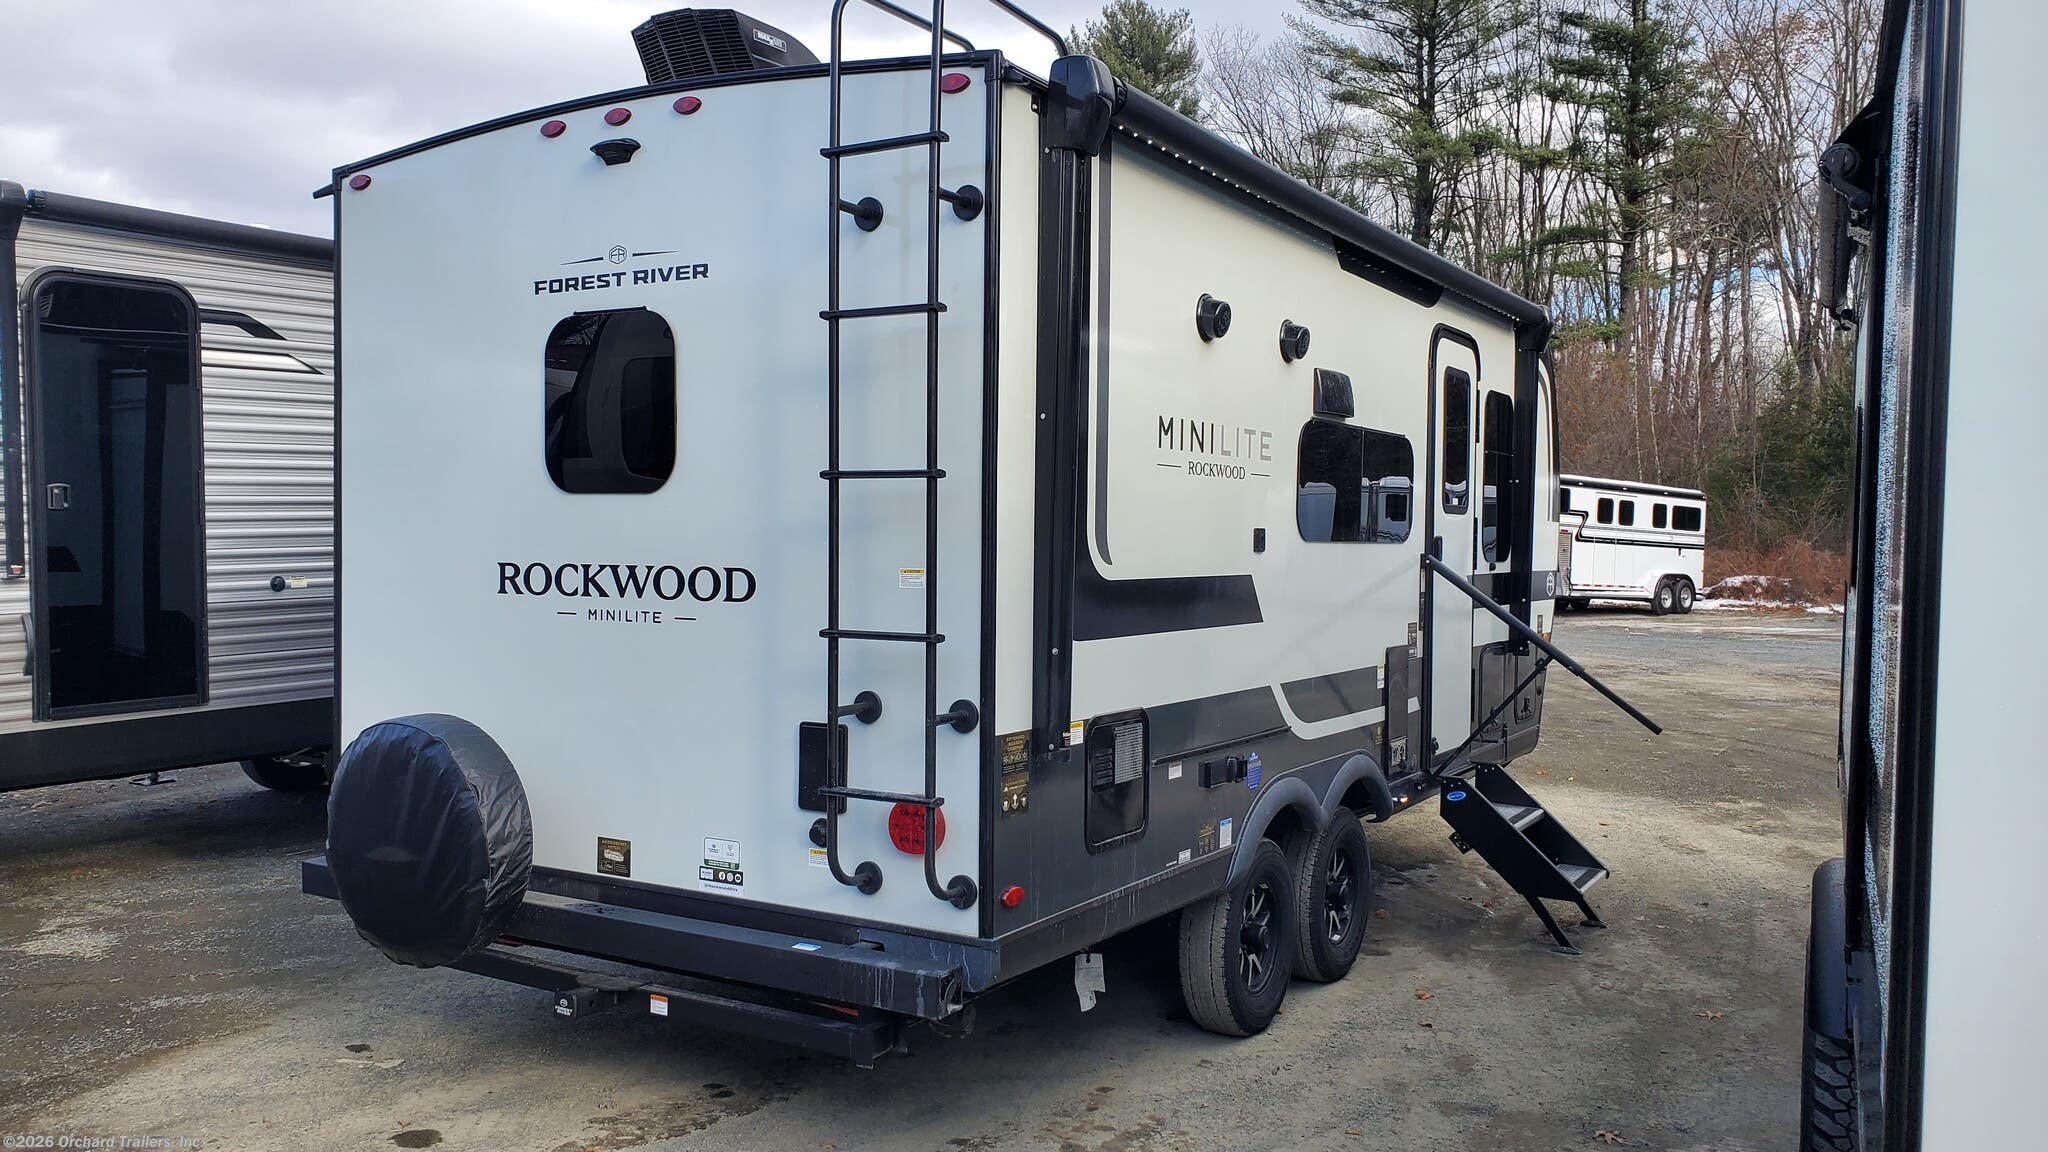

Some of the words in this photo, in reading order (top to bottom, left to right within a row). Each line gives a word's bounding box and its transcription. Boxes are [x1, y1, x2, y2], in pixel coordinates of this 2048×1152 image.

[534, 271, 627, 295] FOREST
[633, 263, 709, 286] RIVER
[1158, 415, 1273, 461] MINILITE
[1188, 461, 1246, 480] ROCKWOOD
[497, 561, 757, 603] ROCKWOOD
[588, 608, 662, 624] MINILITE
